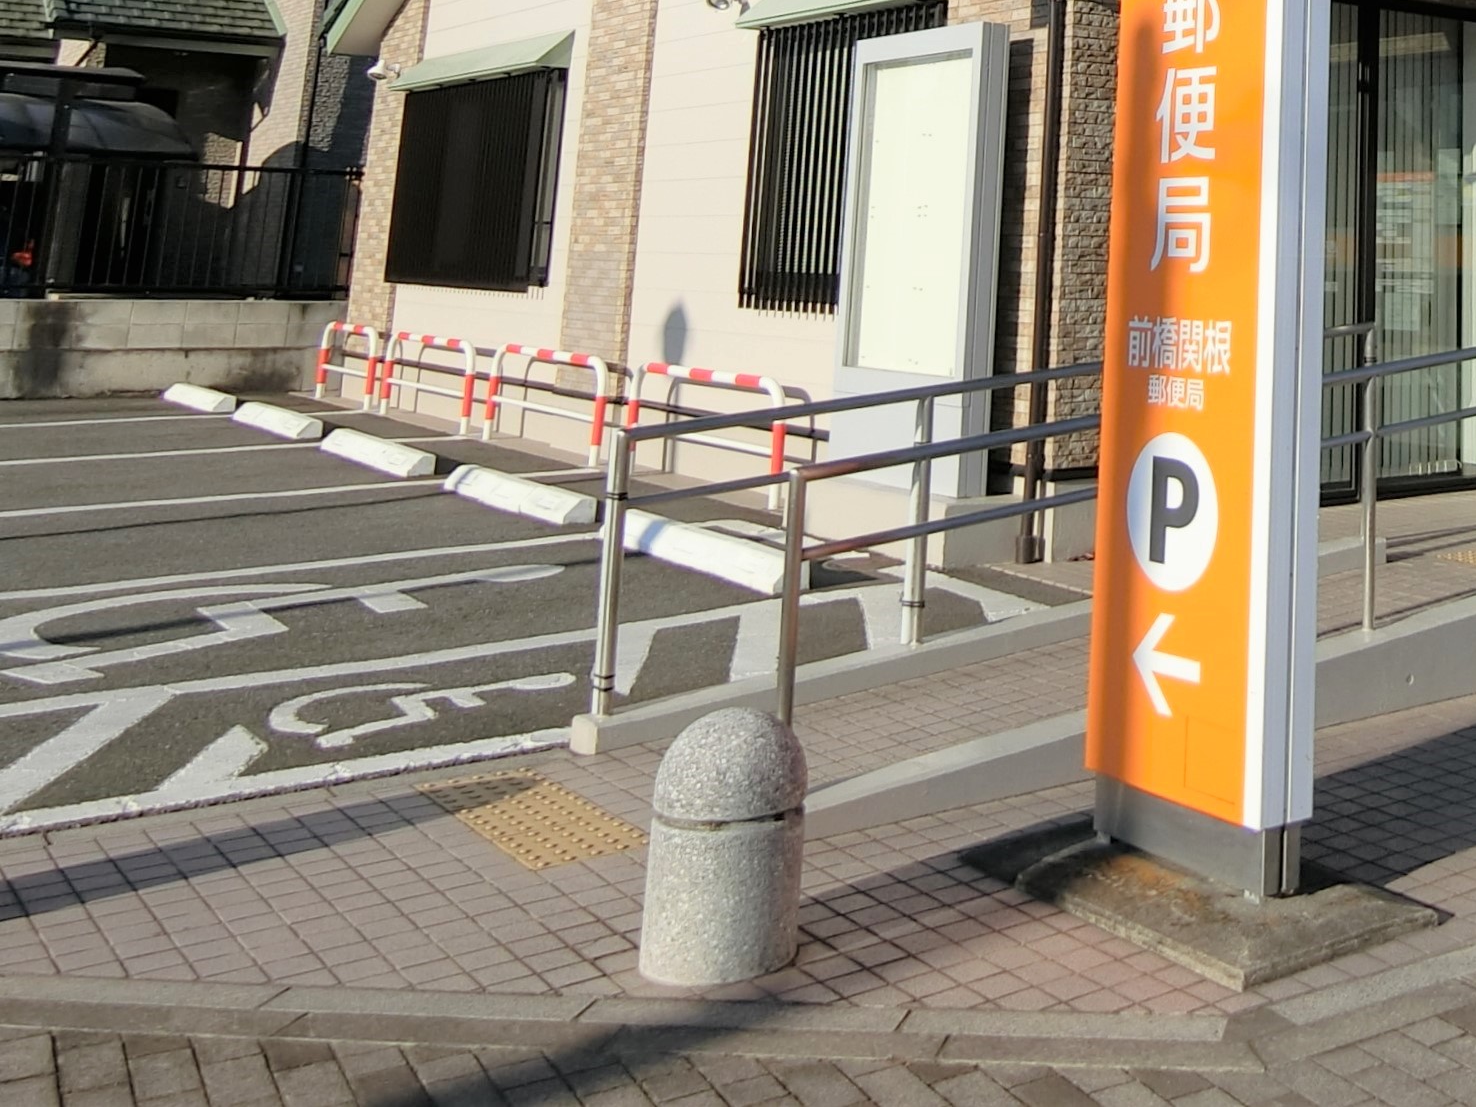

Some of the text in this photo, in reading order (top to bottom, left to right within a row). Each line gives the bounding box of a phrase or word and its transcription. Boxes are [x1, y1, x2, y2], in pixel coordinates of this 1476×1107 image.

[1127, 314, 1233, 375] 前橋関根
[1147, 374, 1205, 411] 郵便局
[1148, 455, 1201, 565] P
